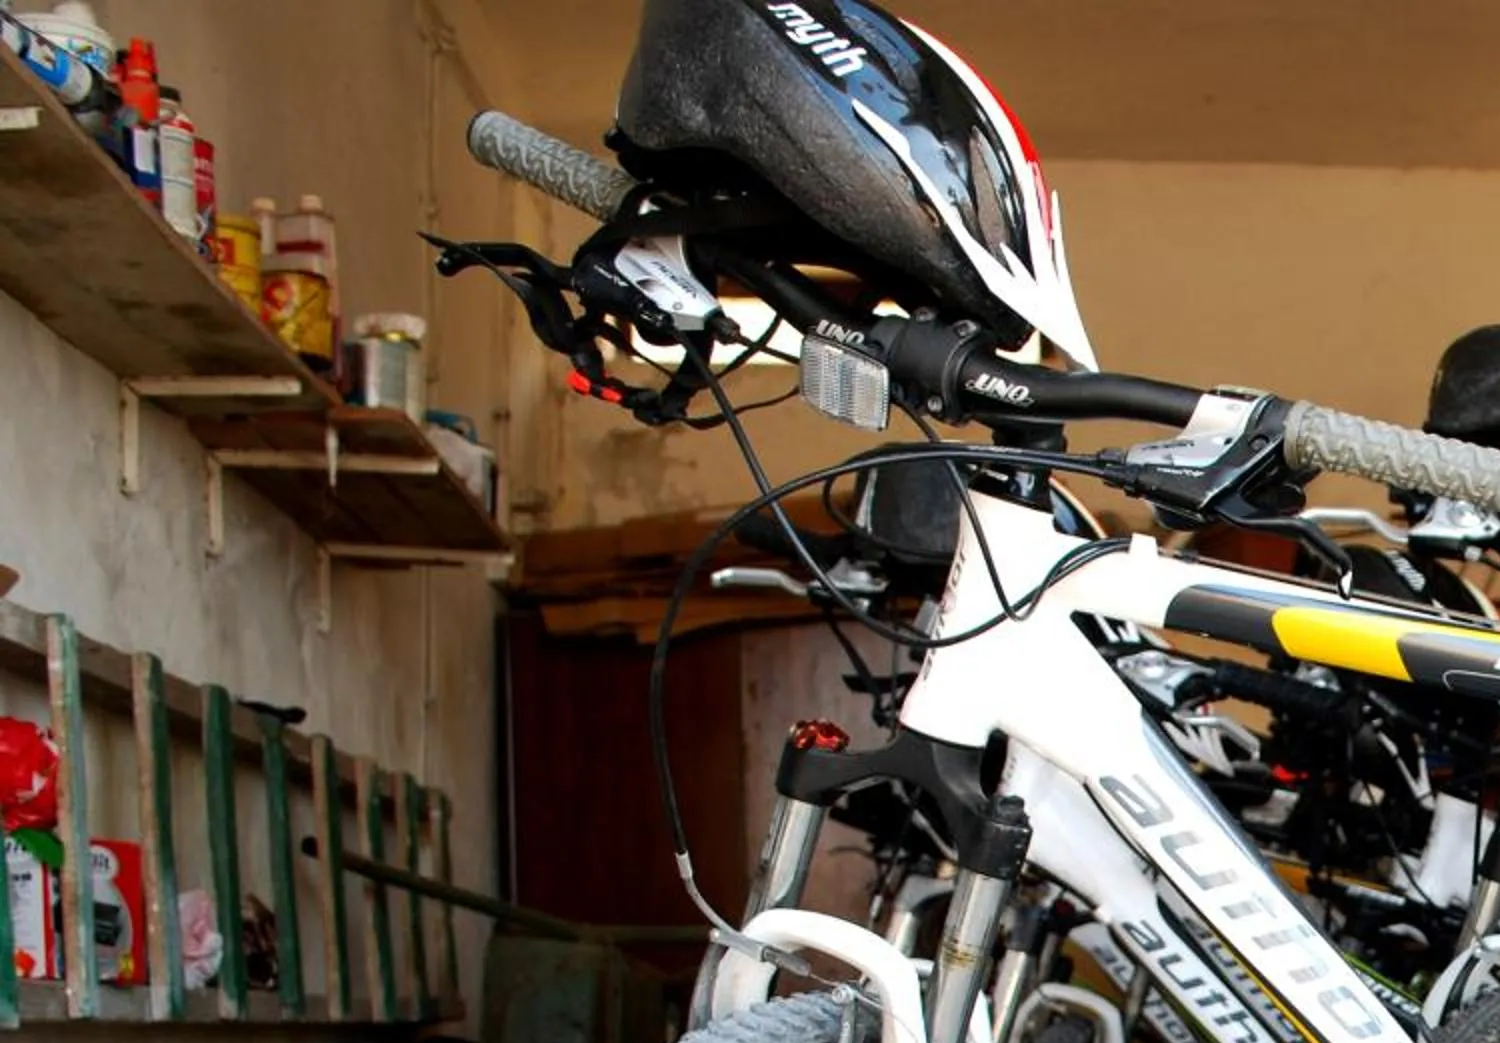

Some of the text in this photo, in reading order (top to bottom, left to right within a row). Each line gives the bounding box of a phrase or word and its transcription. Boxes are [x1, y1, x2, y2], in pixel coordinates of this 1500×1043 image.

[766, 2, 868, 77] myth
[815, 319, 866, 344] UNO
[972, 372, 1031, 402] UNO
